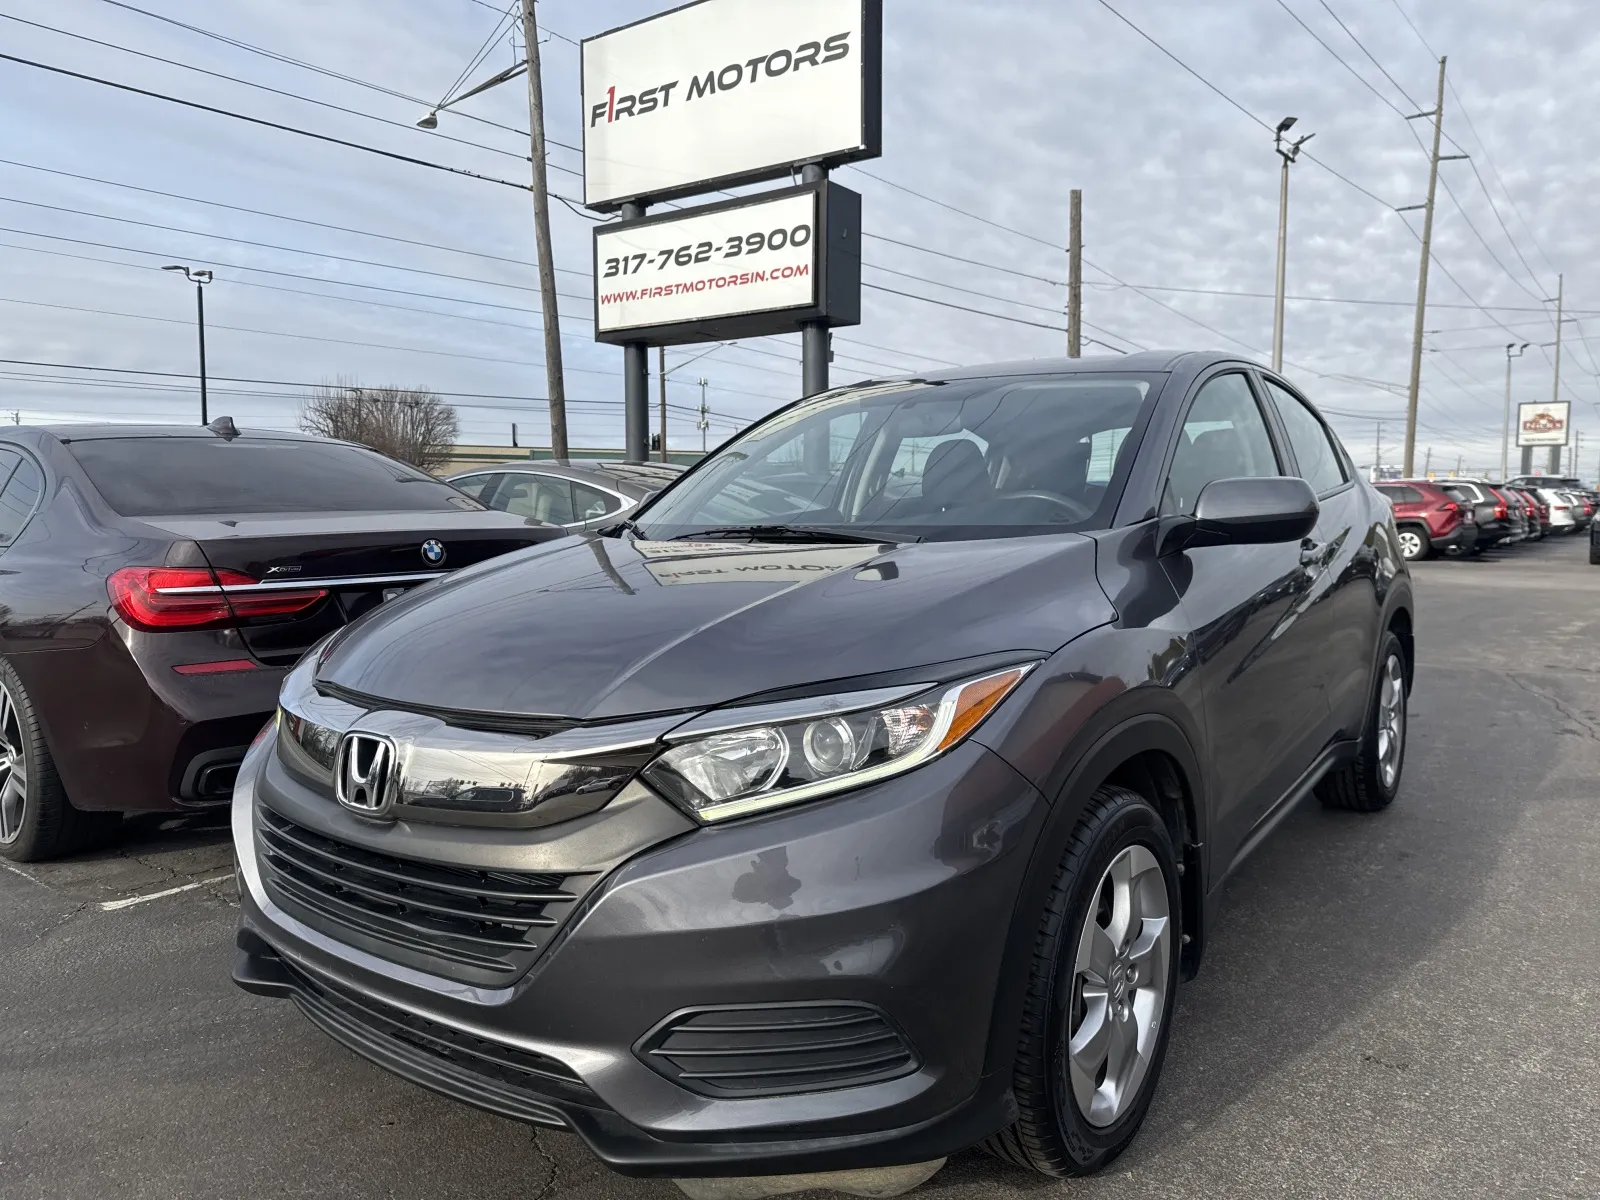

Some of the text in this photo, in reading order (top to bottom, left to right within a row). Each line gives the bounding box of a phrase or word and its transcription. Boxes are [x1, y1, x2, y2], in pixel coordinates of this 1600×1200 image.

[686, 31, 851, 102] MOTORS
[603, 224, 811, 278] 317-762-3900
[600, 264, 809, 305] WWW.FIRSTMOTORSIN.COM
